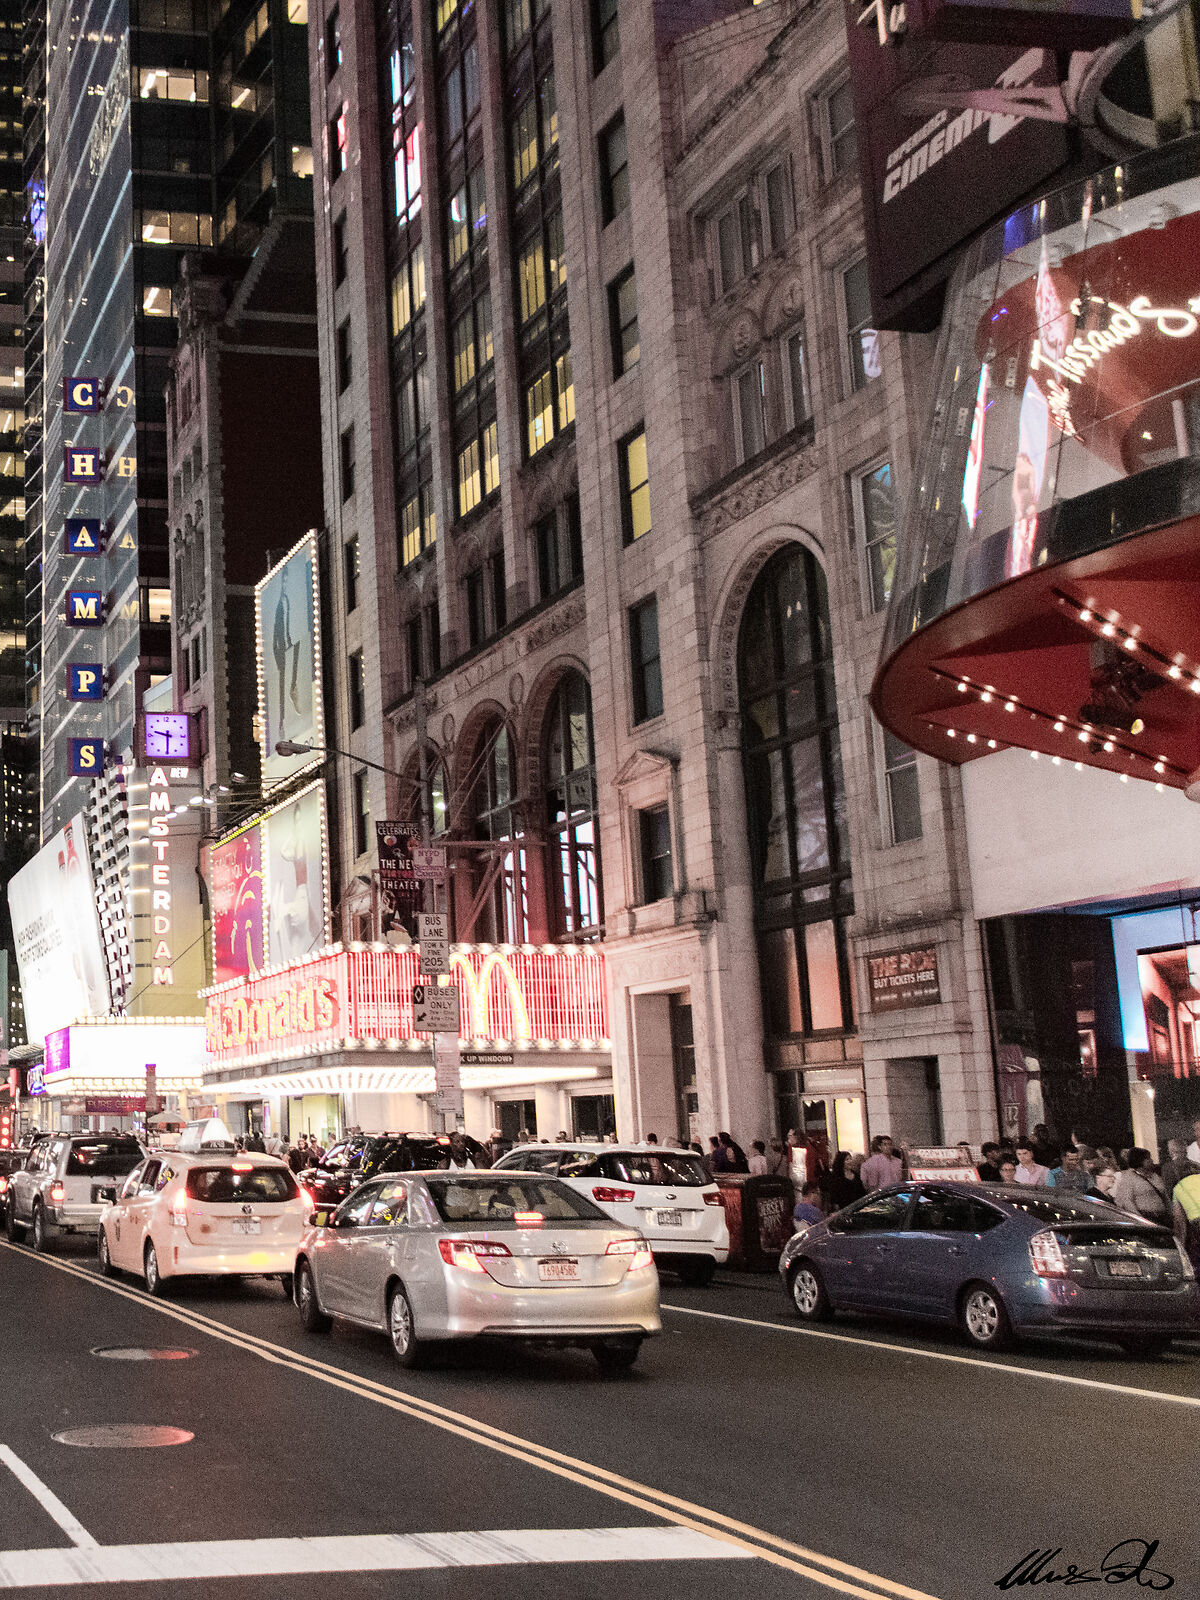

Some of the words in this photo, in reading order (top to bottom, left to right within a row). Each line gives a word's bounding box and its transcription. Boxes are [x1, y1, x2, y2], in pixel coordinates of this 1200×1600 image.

[71, 383, 98, 768] CHAMPS
[377, 827, 418, 836] CELEBRATES
[381, 858, 396, 870] THE
[398, 859, 414, 870] NE
[149, 767, 175, 987] AMSTERDAM
[381, 880, 420, 890] THEATER
[425, 916, 441, 925] BUS
[423, 928, 444, 937] LANE
[874, 977, 888, 989] BUY
[889, 974, 915, 986] TICKETS
[916, 970, 935, 982] HERE
[427, 988, 455, 996] BUSES
[430, 1001, 452, 1009] ONLY
[206, 976, 334, 1052] McDonald's
